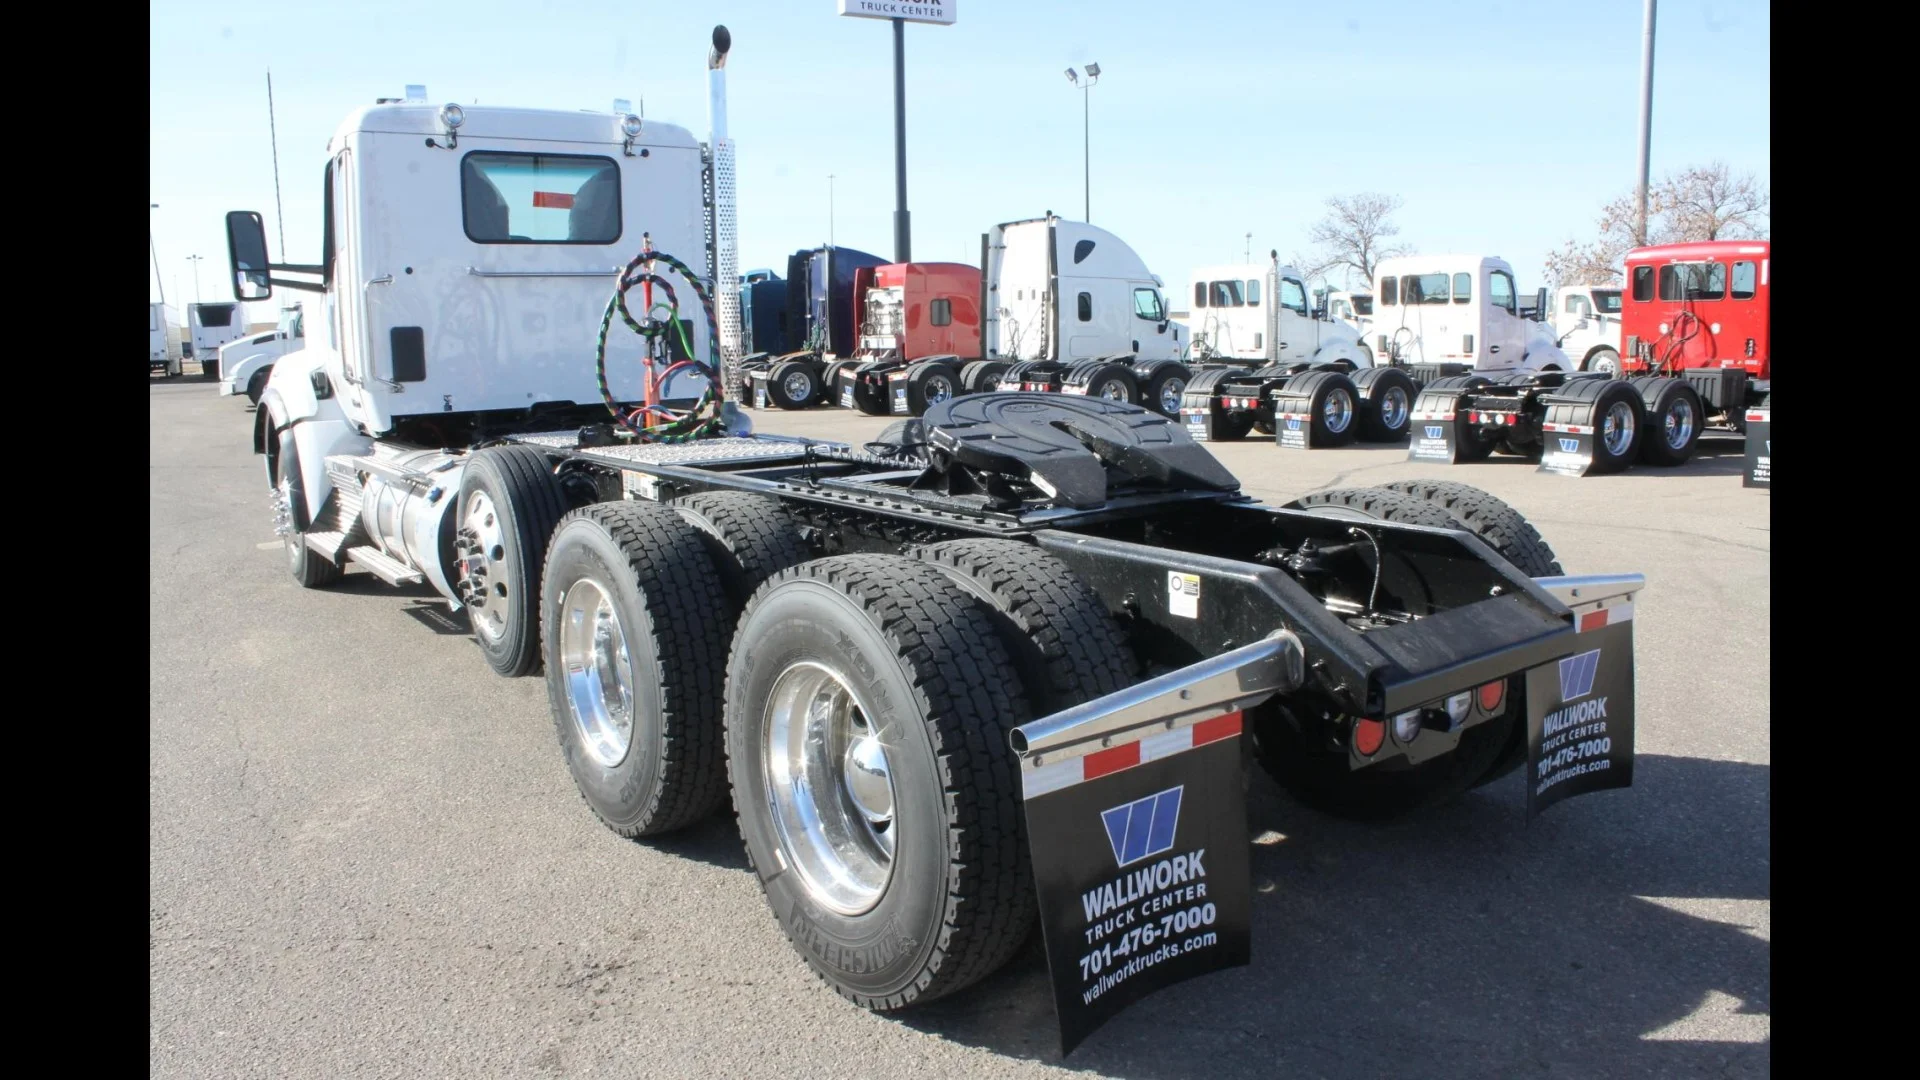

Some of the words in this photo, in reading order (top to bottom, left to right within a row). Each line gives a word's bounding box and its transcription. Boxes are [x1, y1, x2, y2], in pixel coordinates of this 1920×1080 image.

[860, 2, 896, 12] TRUCK
[901, 6, 943, 17] CENTER
[1542, 734, 1565, 753] TRUCK
[1568, 721, 1606, 740] CENTER
[1543, 697, 1608, 738] WALLWORK
[1536, 759, 1610, 796] wallworktrucks.com
[1538, 737, 1611, 779] 701-476-7000
[1082, 849, 1206, 922] WALLWORK
[1085, 910, 1135, 945] TRUCK
[1141, 883, 1207, 916] CENTER
[1079, 902, 1216, 981] 701-476-7000
[1083, 932, 1217, 1005] wallworktrucks.com
